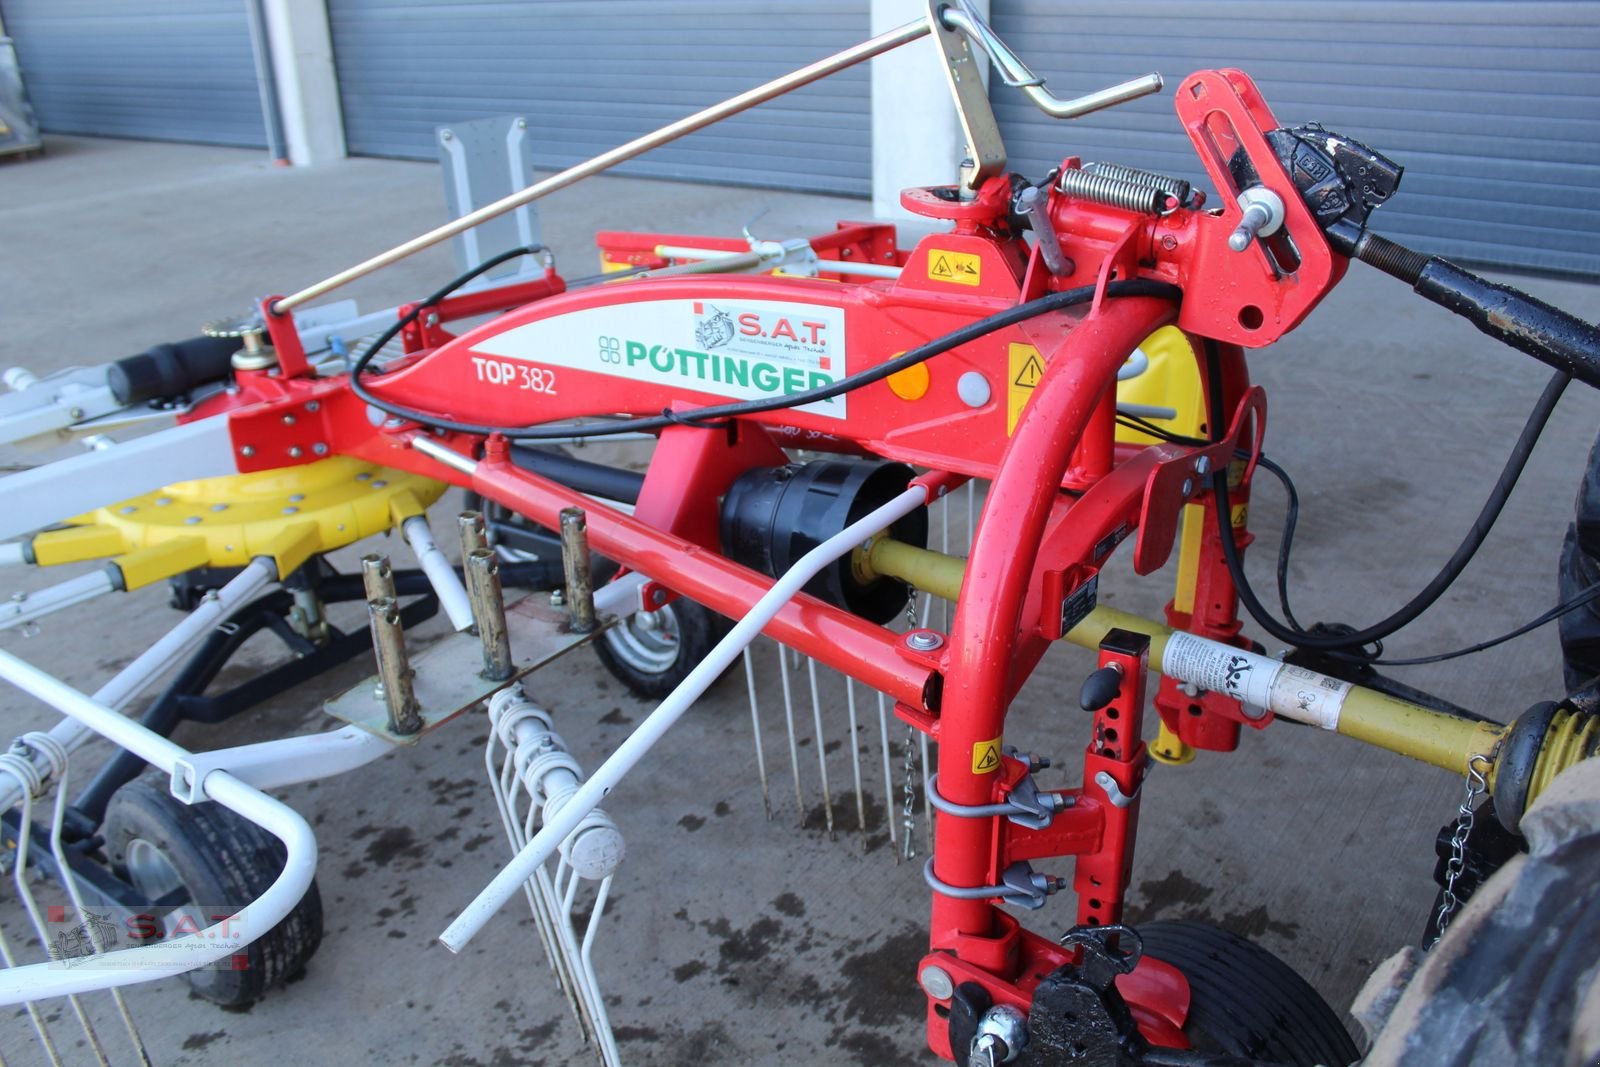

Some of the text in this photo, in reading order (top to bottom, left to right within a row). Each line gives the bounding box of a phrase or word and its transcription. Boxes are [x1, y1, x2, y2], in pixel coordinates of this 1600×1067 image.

[738, 312, 826, 346] S.A.T.
[471, 357, 558, 395] TOP 382
